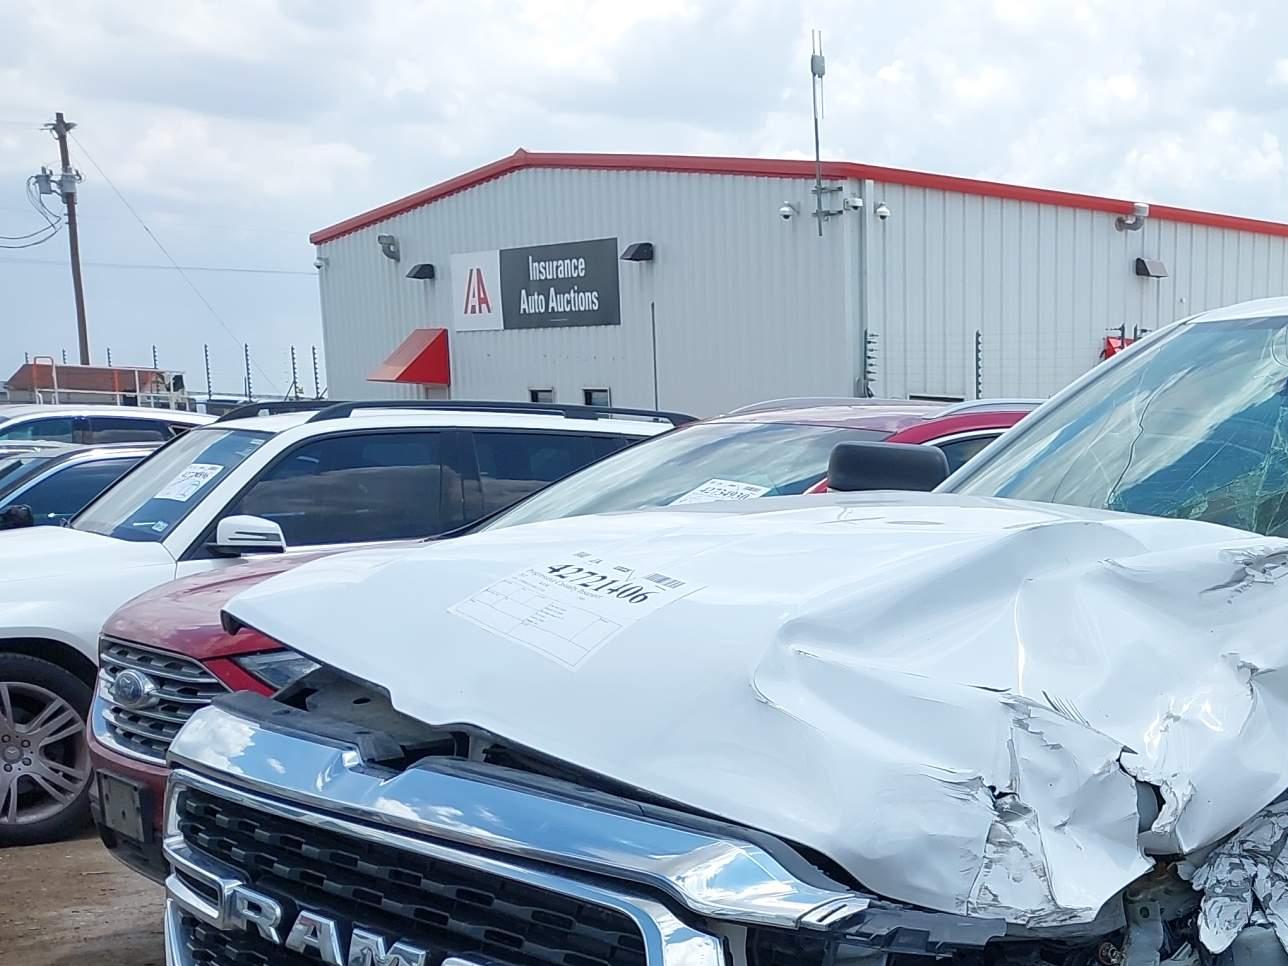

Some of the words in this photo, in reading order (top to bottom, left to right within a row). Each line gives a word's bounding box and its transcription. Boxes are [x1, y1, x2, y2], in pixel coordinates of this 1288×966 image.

[528, 255, 586, 281] Insurance
[519, 288, 546, 315] Auto
[548, 285, 599, 313] Auctions
[547, 564, 658, 604] 42721406
